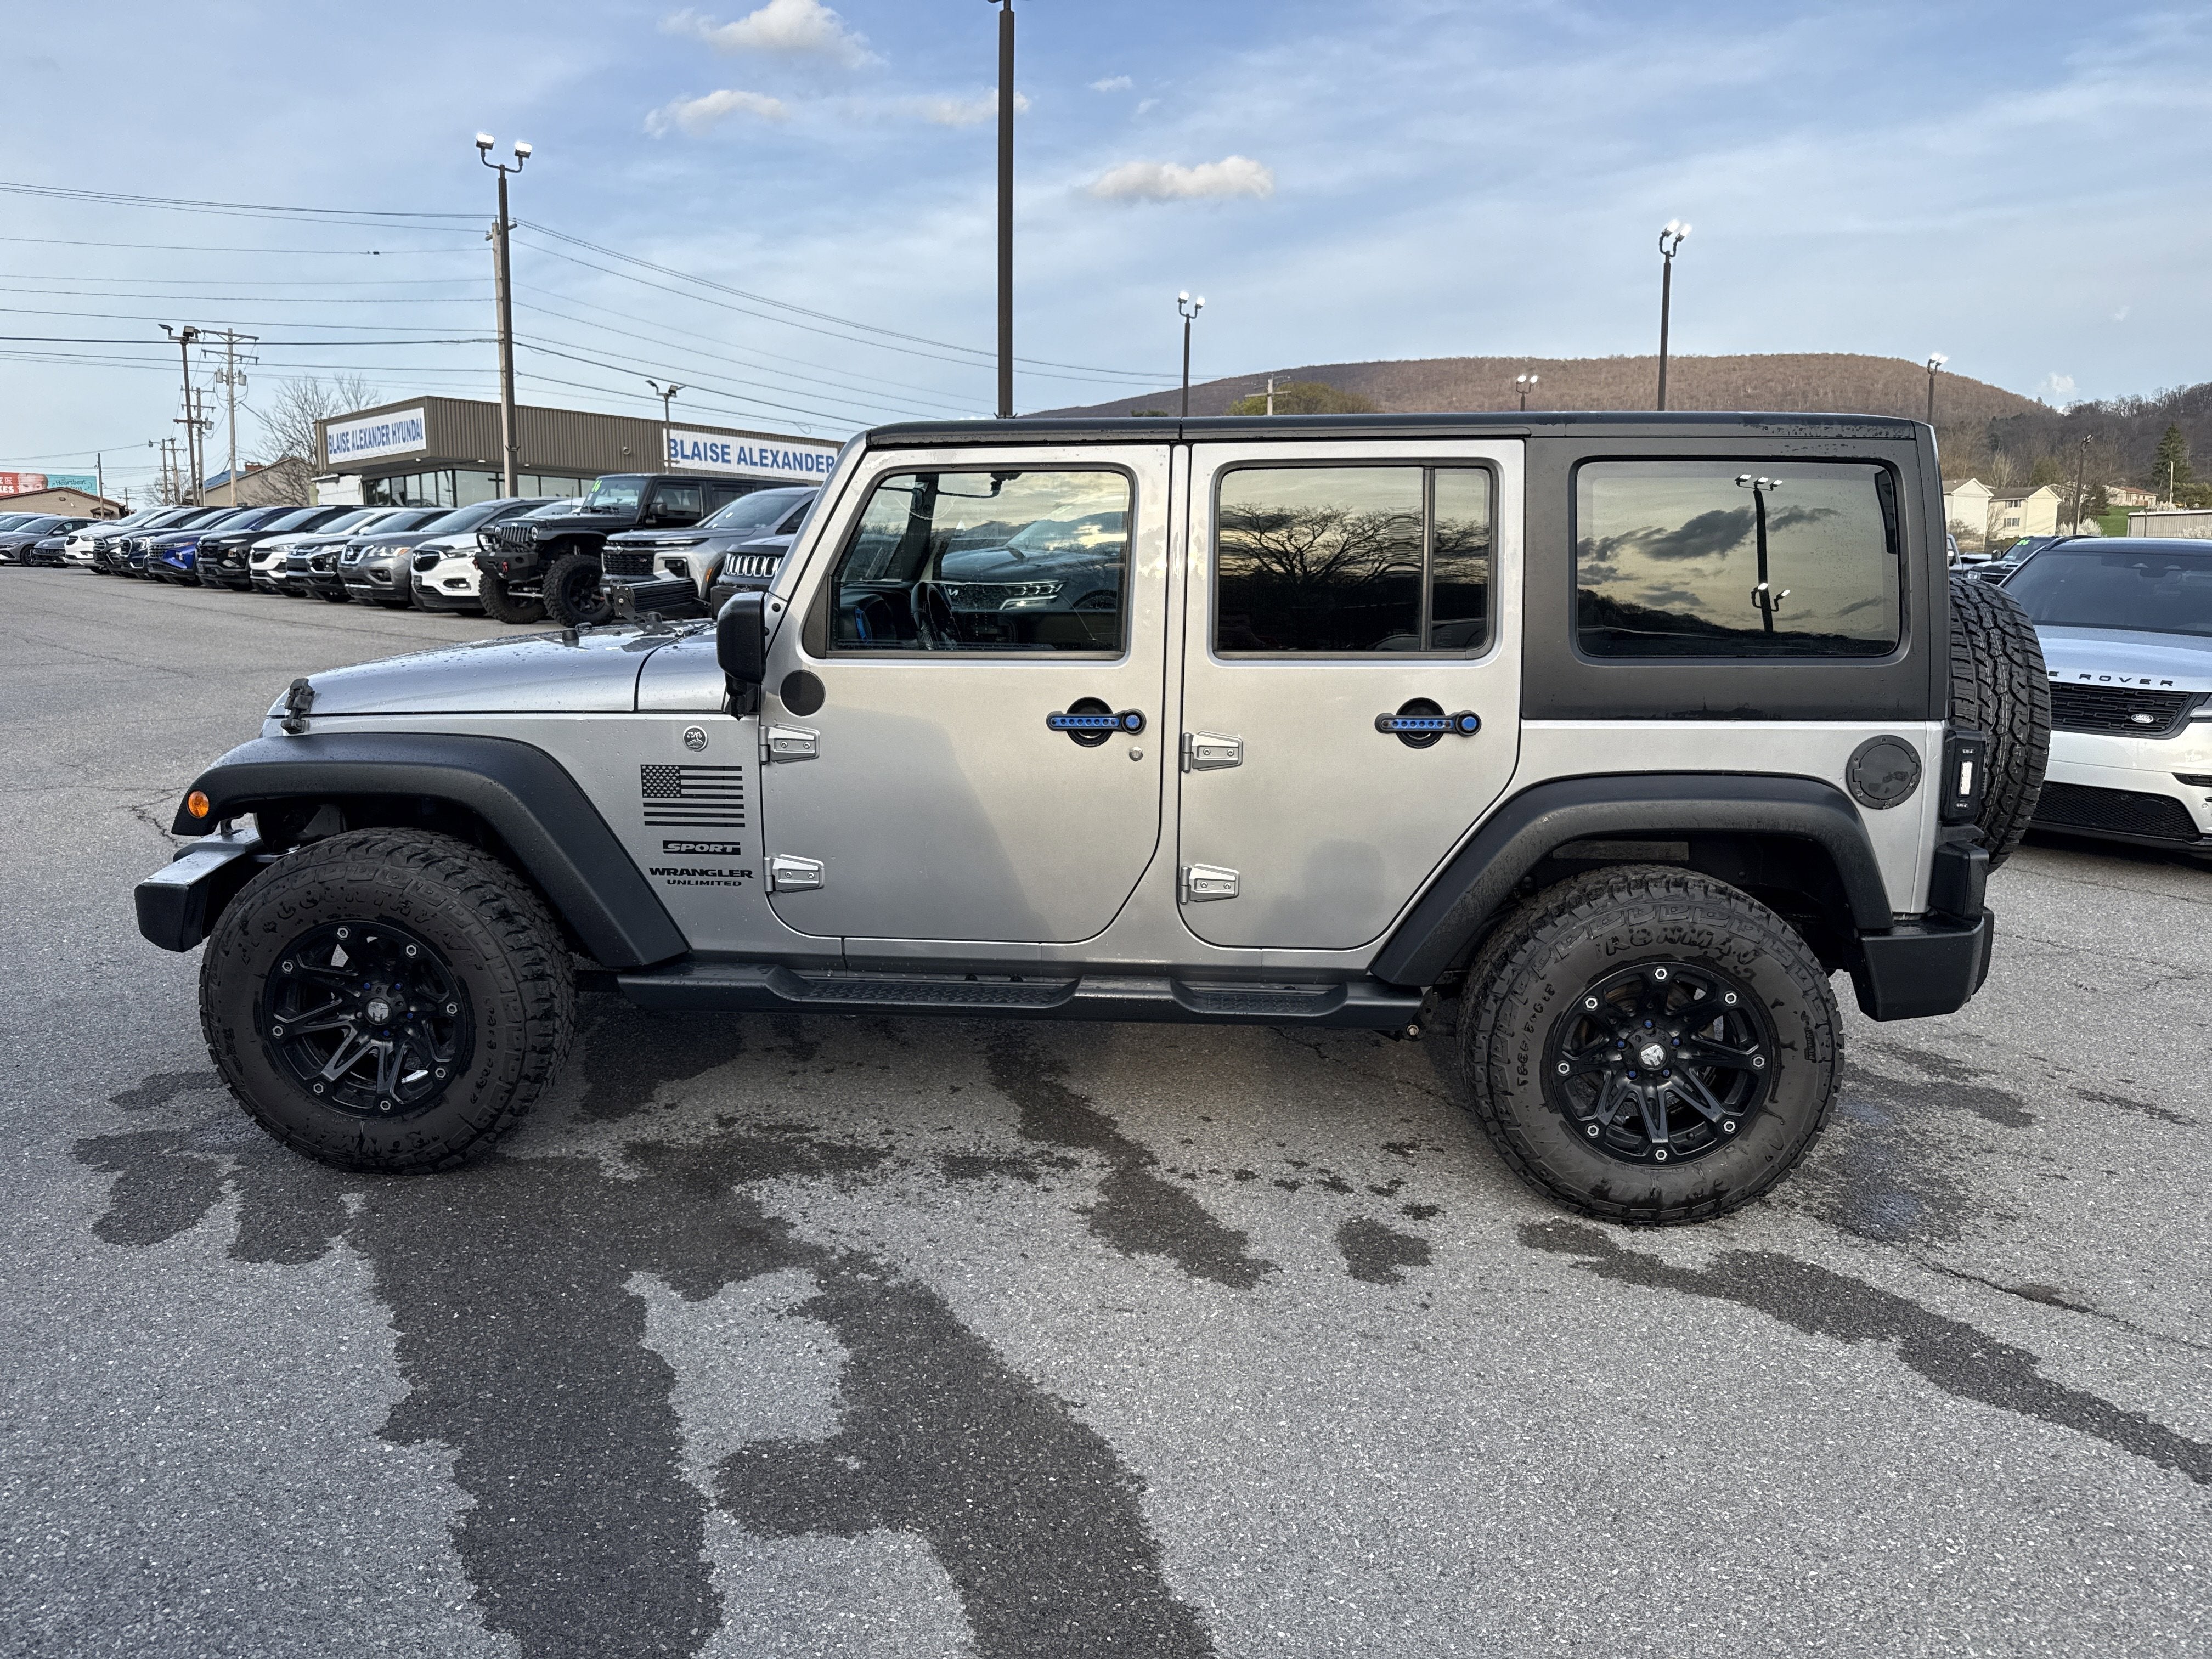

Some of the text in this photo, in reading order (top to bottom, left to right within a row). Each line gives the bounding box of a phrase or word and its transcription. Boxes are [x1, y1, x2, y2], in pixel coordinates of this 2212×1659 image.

[329, 418, 423, 454] BLAISE ALEXANDER HYUNDAI
[669, 438, 836, 474] BLAISE ALEXANDER
[2079, 674, 2174, 686] ROVER
[663, 843, 741, 853] SPORT
[649, 868, 754, 879] WRANGLER
